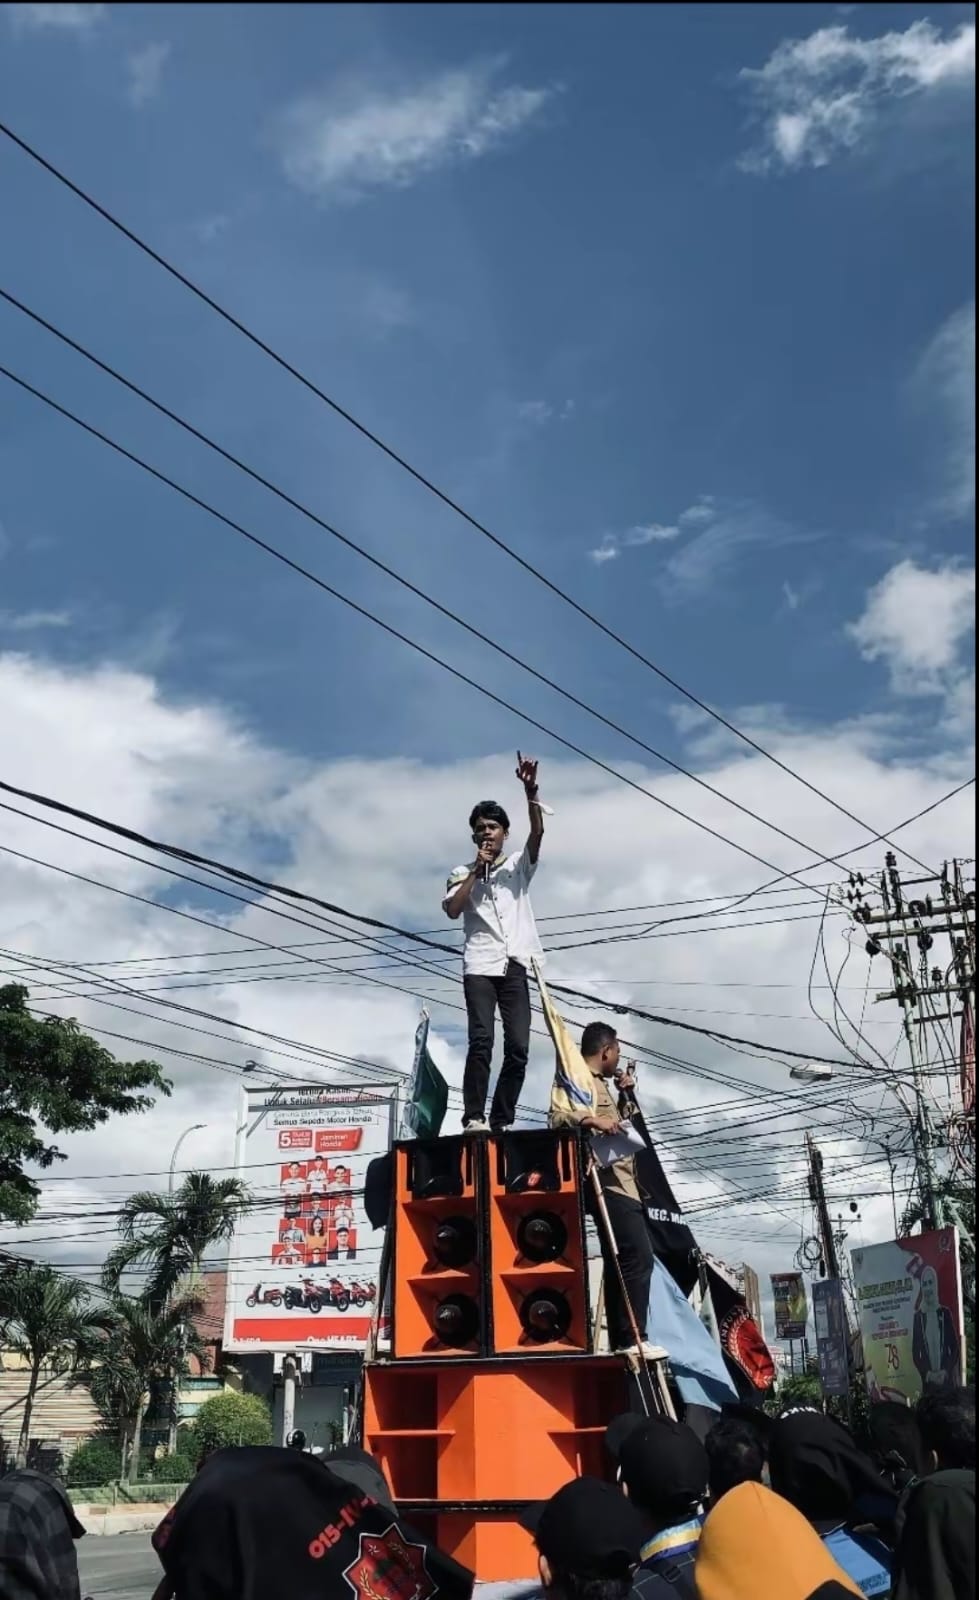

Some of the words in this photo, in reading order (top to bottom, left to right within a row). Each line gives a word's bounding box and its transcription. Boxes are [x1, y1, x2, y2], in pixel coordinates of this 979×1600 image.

[299, 1117, 325, 1127] Sepeda
[326, 1116, 348, 1124] Motor
[348, 1115, 372, 1123] Honda
[280, 1132, 291, 1147] 5
[648, 1207, 670, 1222] KEC.
